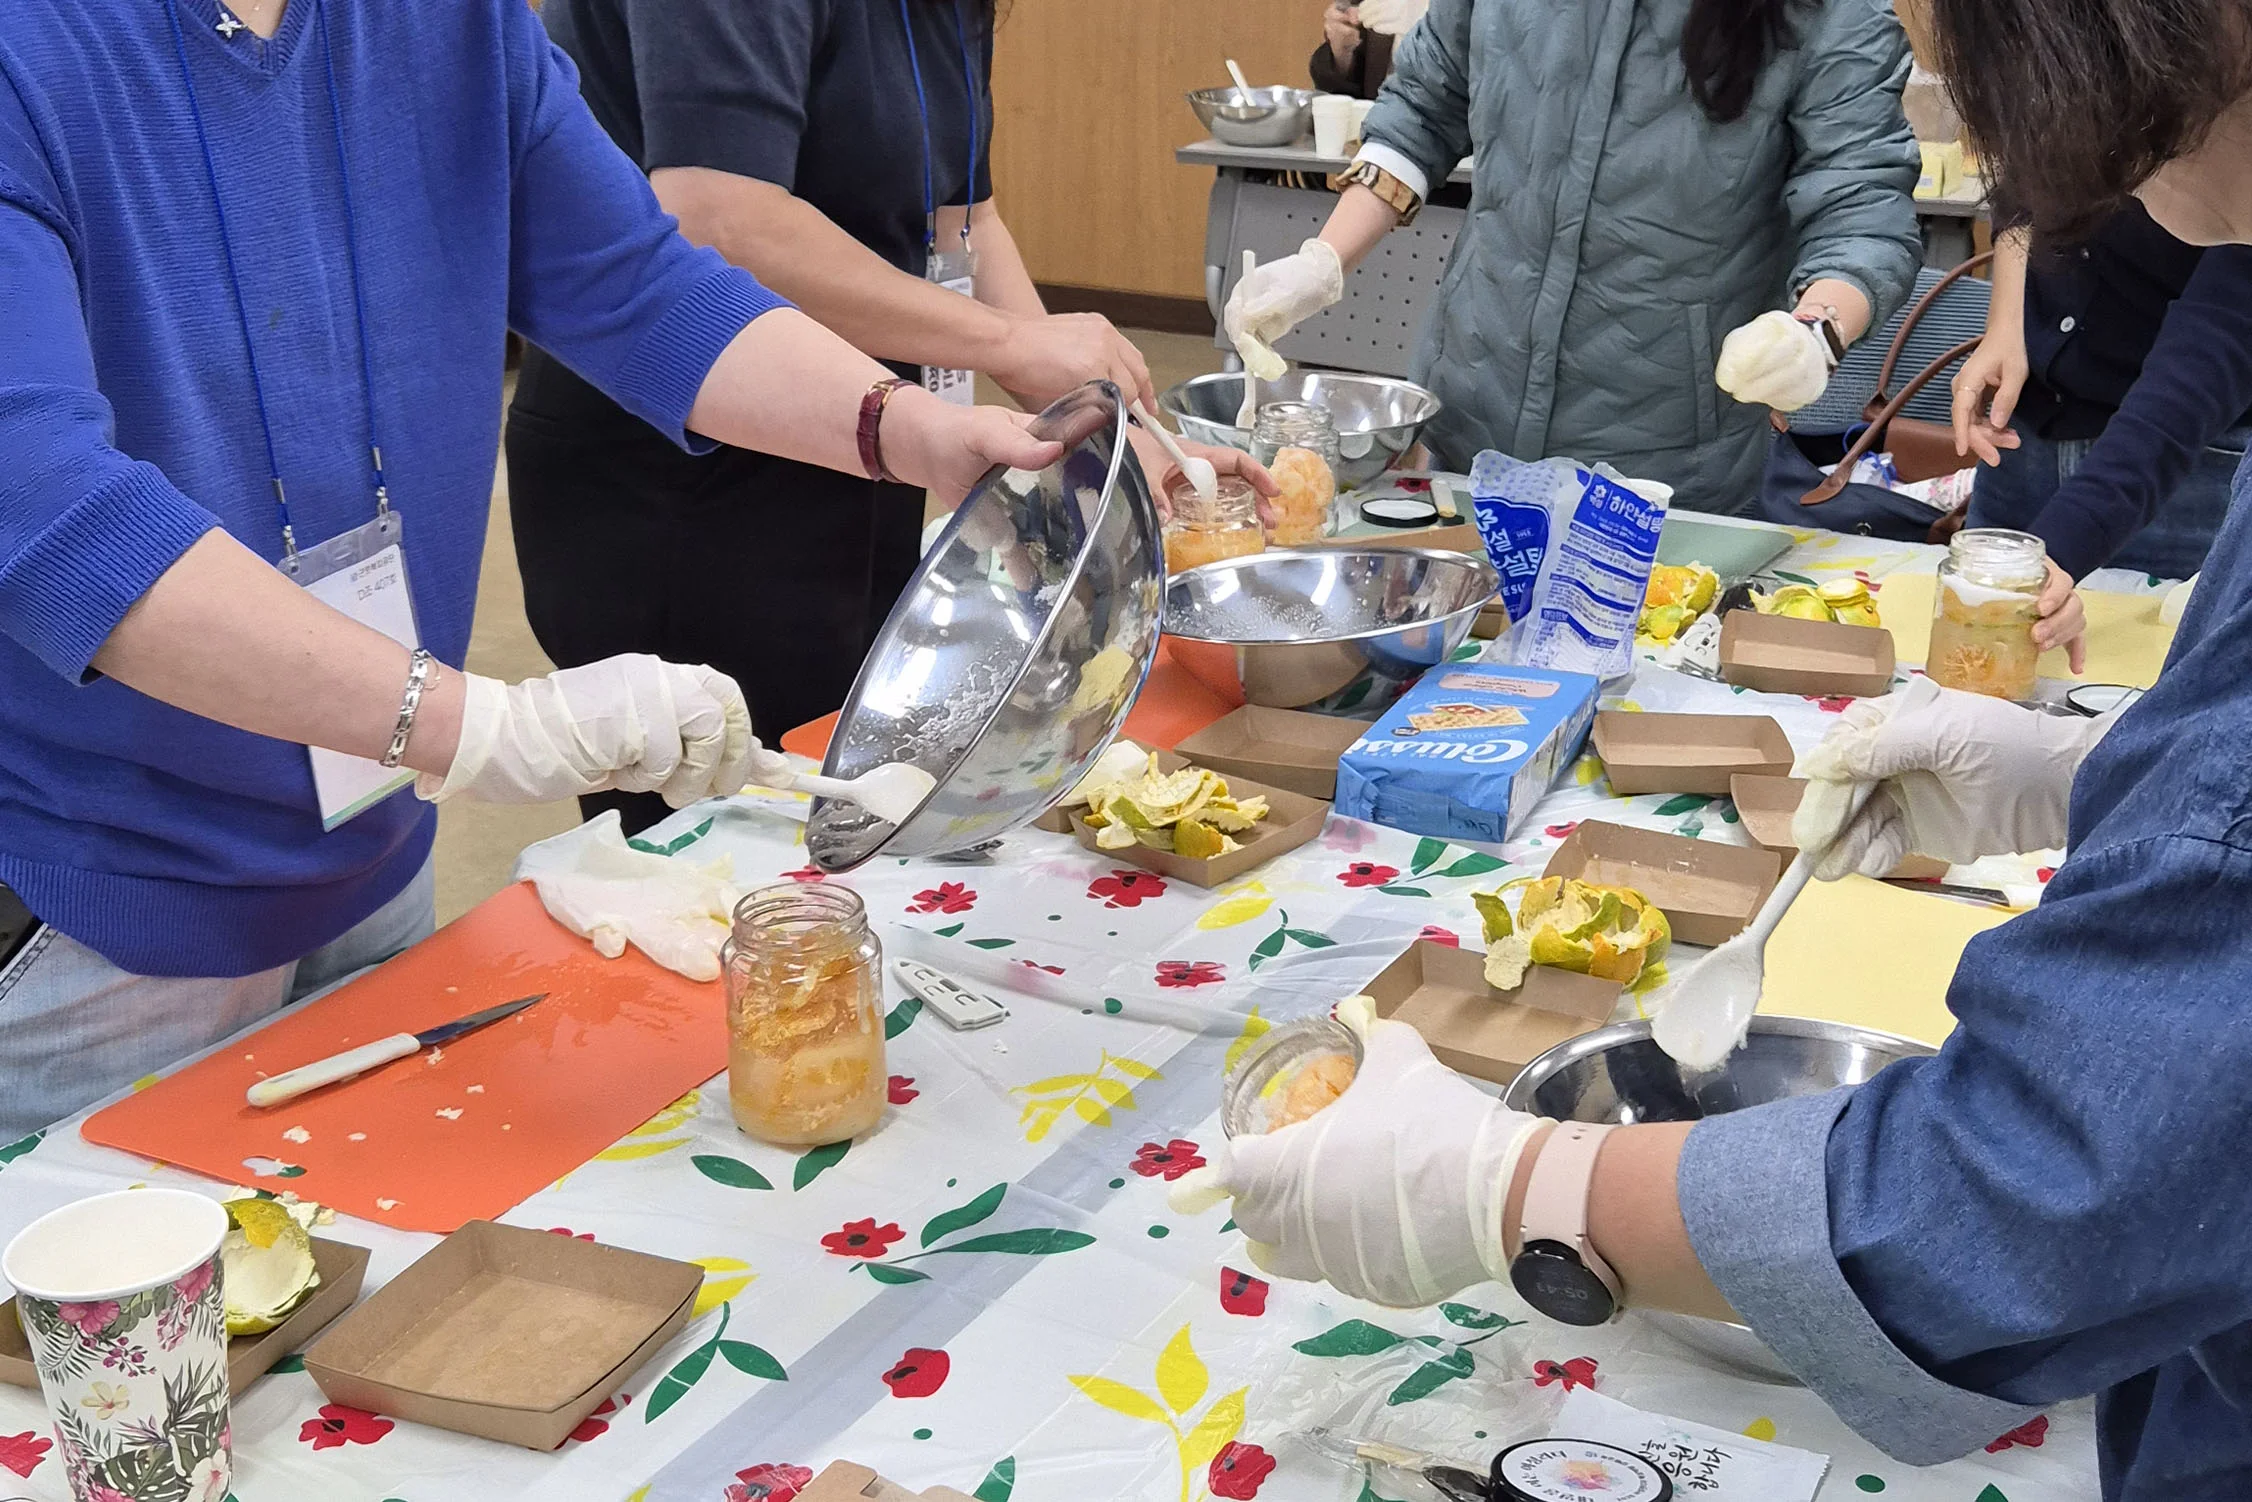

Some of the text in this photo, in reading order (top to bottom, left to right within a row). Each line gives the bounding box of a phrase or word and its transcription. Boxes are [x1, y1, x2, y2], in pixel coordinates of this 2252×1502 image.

[1484, 525, 1513, 555] 설
[1491, 546, 1544, 578] 설탕
[1344, 738, 1529, 764] Colussi
[1662, 1443, 1699, 1477] 응원
[1688, 1446, 1733, 1491] 합니다
